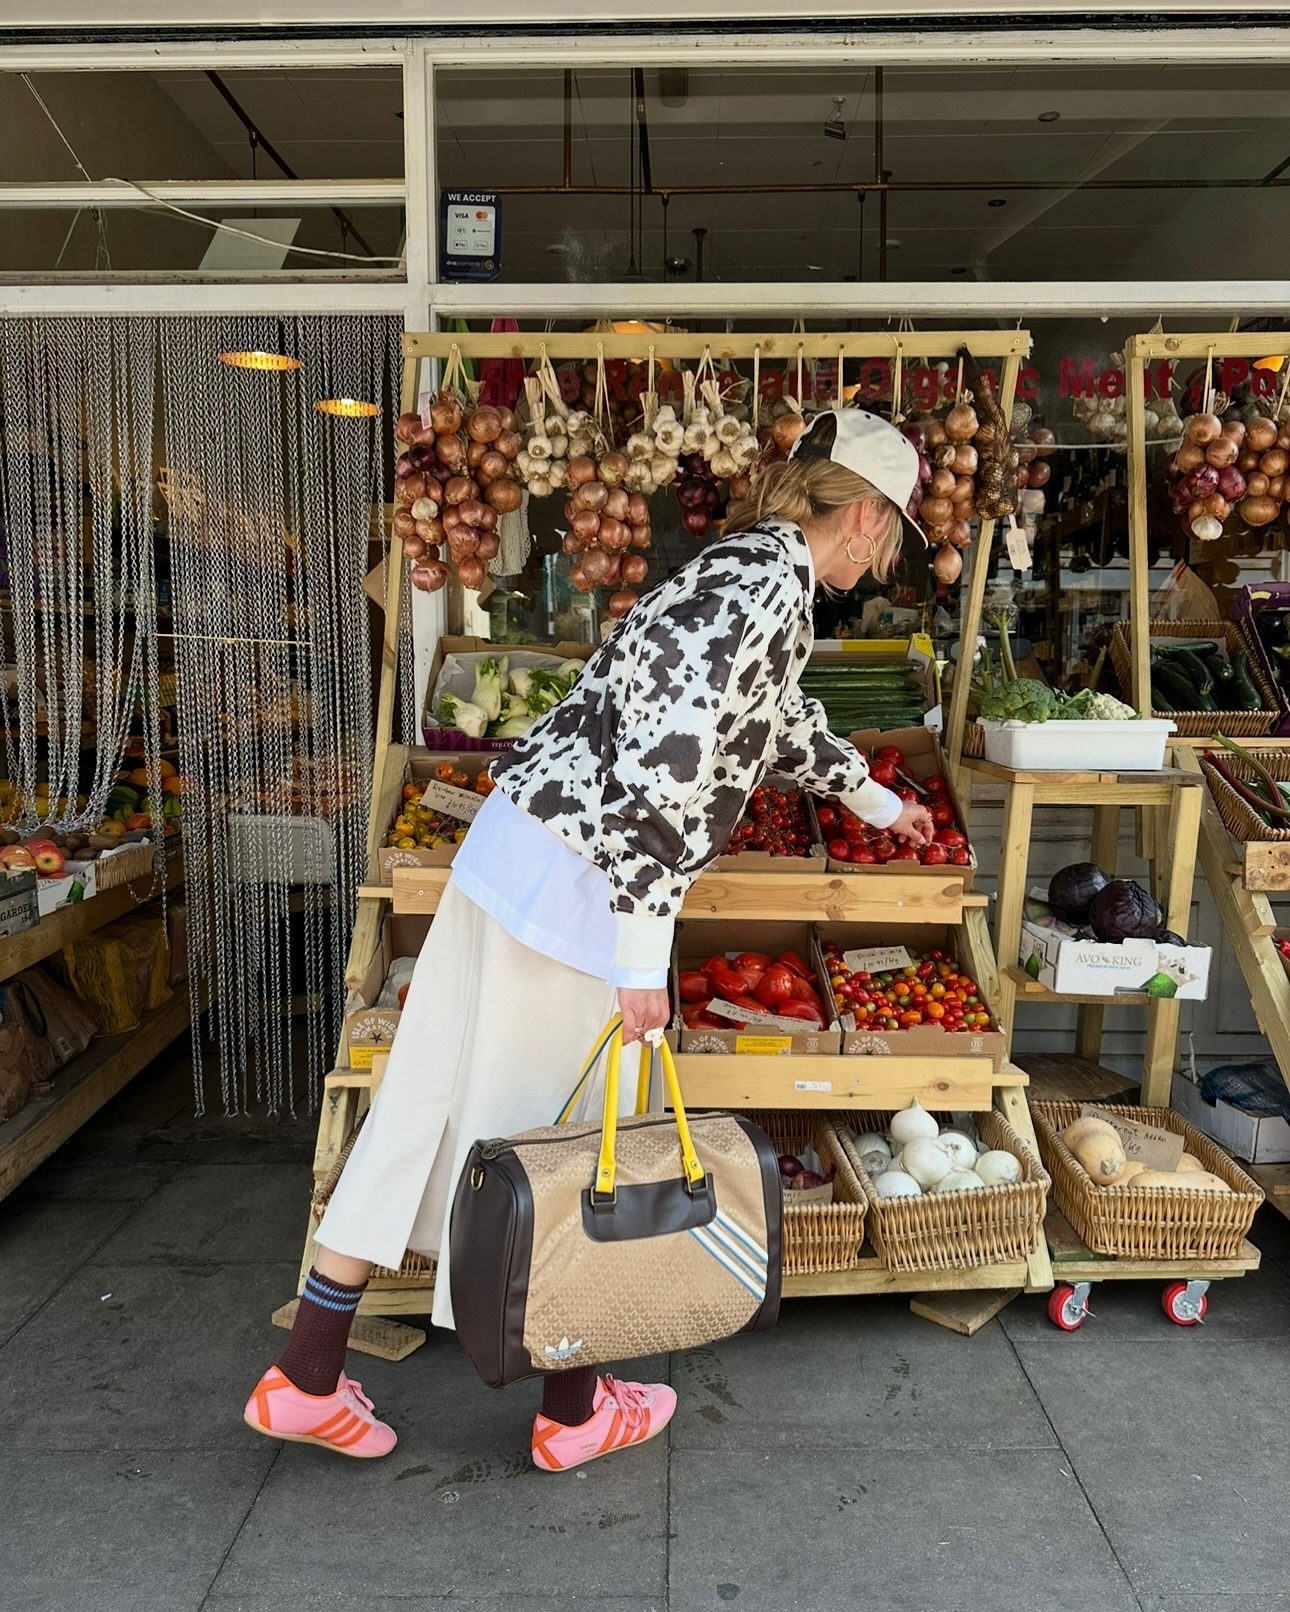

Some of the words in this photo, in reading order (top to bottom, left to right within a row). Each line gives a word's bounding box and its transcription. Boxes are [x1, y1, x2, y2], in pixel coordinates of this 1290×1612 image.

[448, 193, 461, 201] WE
[462, 194, 496, 202] ACCEPT
[1059, 356, 1203, 411] Met,
[404, 852, 422, 867] WIGH
[1075, 954, 1100, 964] AVO
[1112, 956, 1142, 966] KING
[351, 1021, 366, 1039] ISLE
[363, 1017, 375, 1025] OF
[377, 1017, 398, 1036] WIGH
[360, 1024, 393, 1039] TOMATOES
